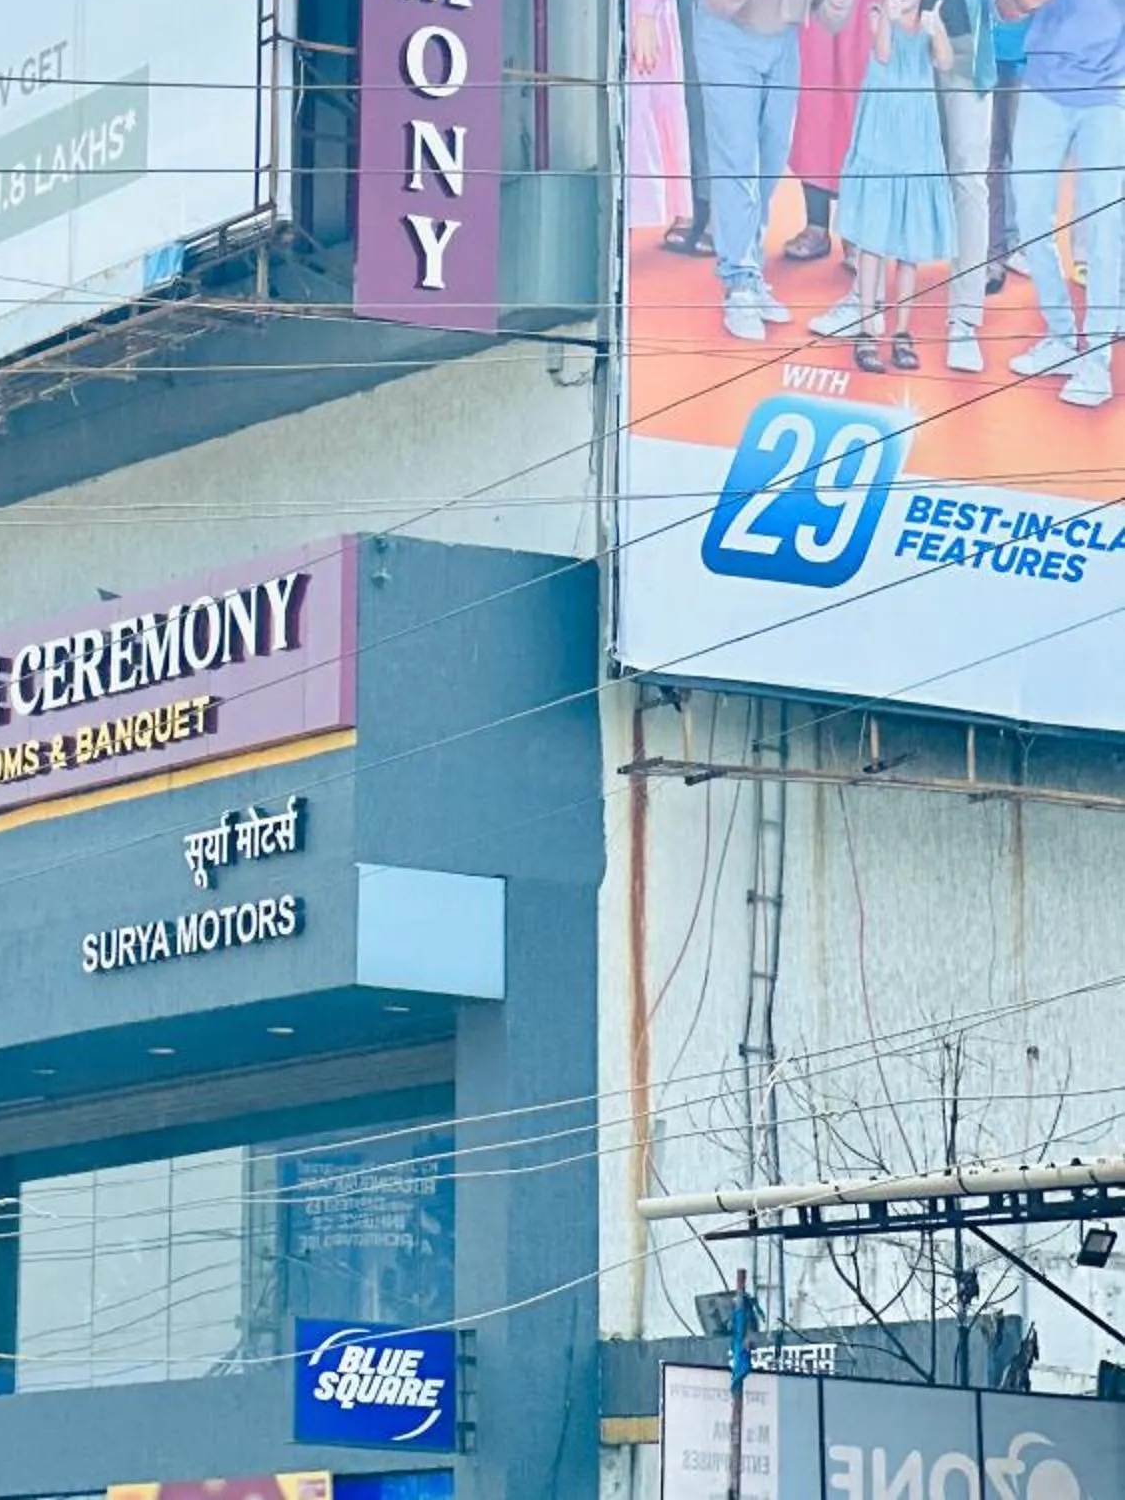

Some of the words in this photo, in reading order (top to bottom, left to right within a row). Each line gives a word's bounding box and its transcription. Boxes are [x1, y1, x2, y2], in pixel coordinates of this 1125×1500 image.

[19, 39, 69, 97] GET
[780, 363, 852, 396] WITH
[719, 412, 885, 565] 29
[894, 529, 1088, 584] FEATURES
[9, 572, 301, 717] CEREMONY
[49, 735, 67, 770] &
[75, 695, 212, 762] BANQUET
[82, 920, 170, 973] SURYA
[176, 894, 297, 956] MOTORS
[314, 1372, 445, 1410] SQUARE
[337, 1345, 424, 1379] BLUE
